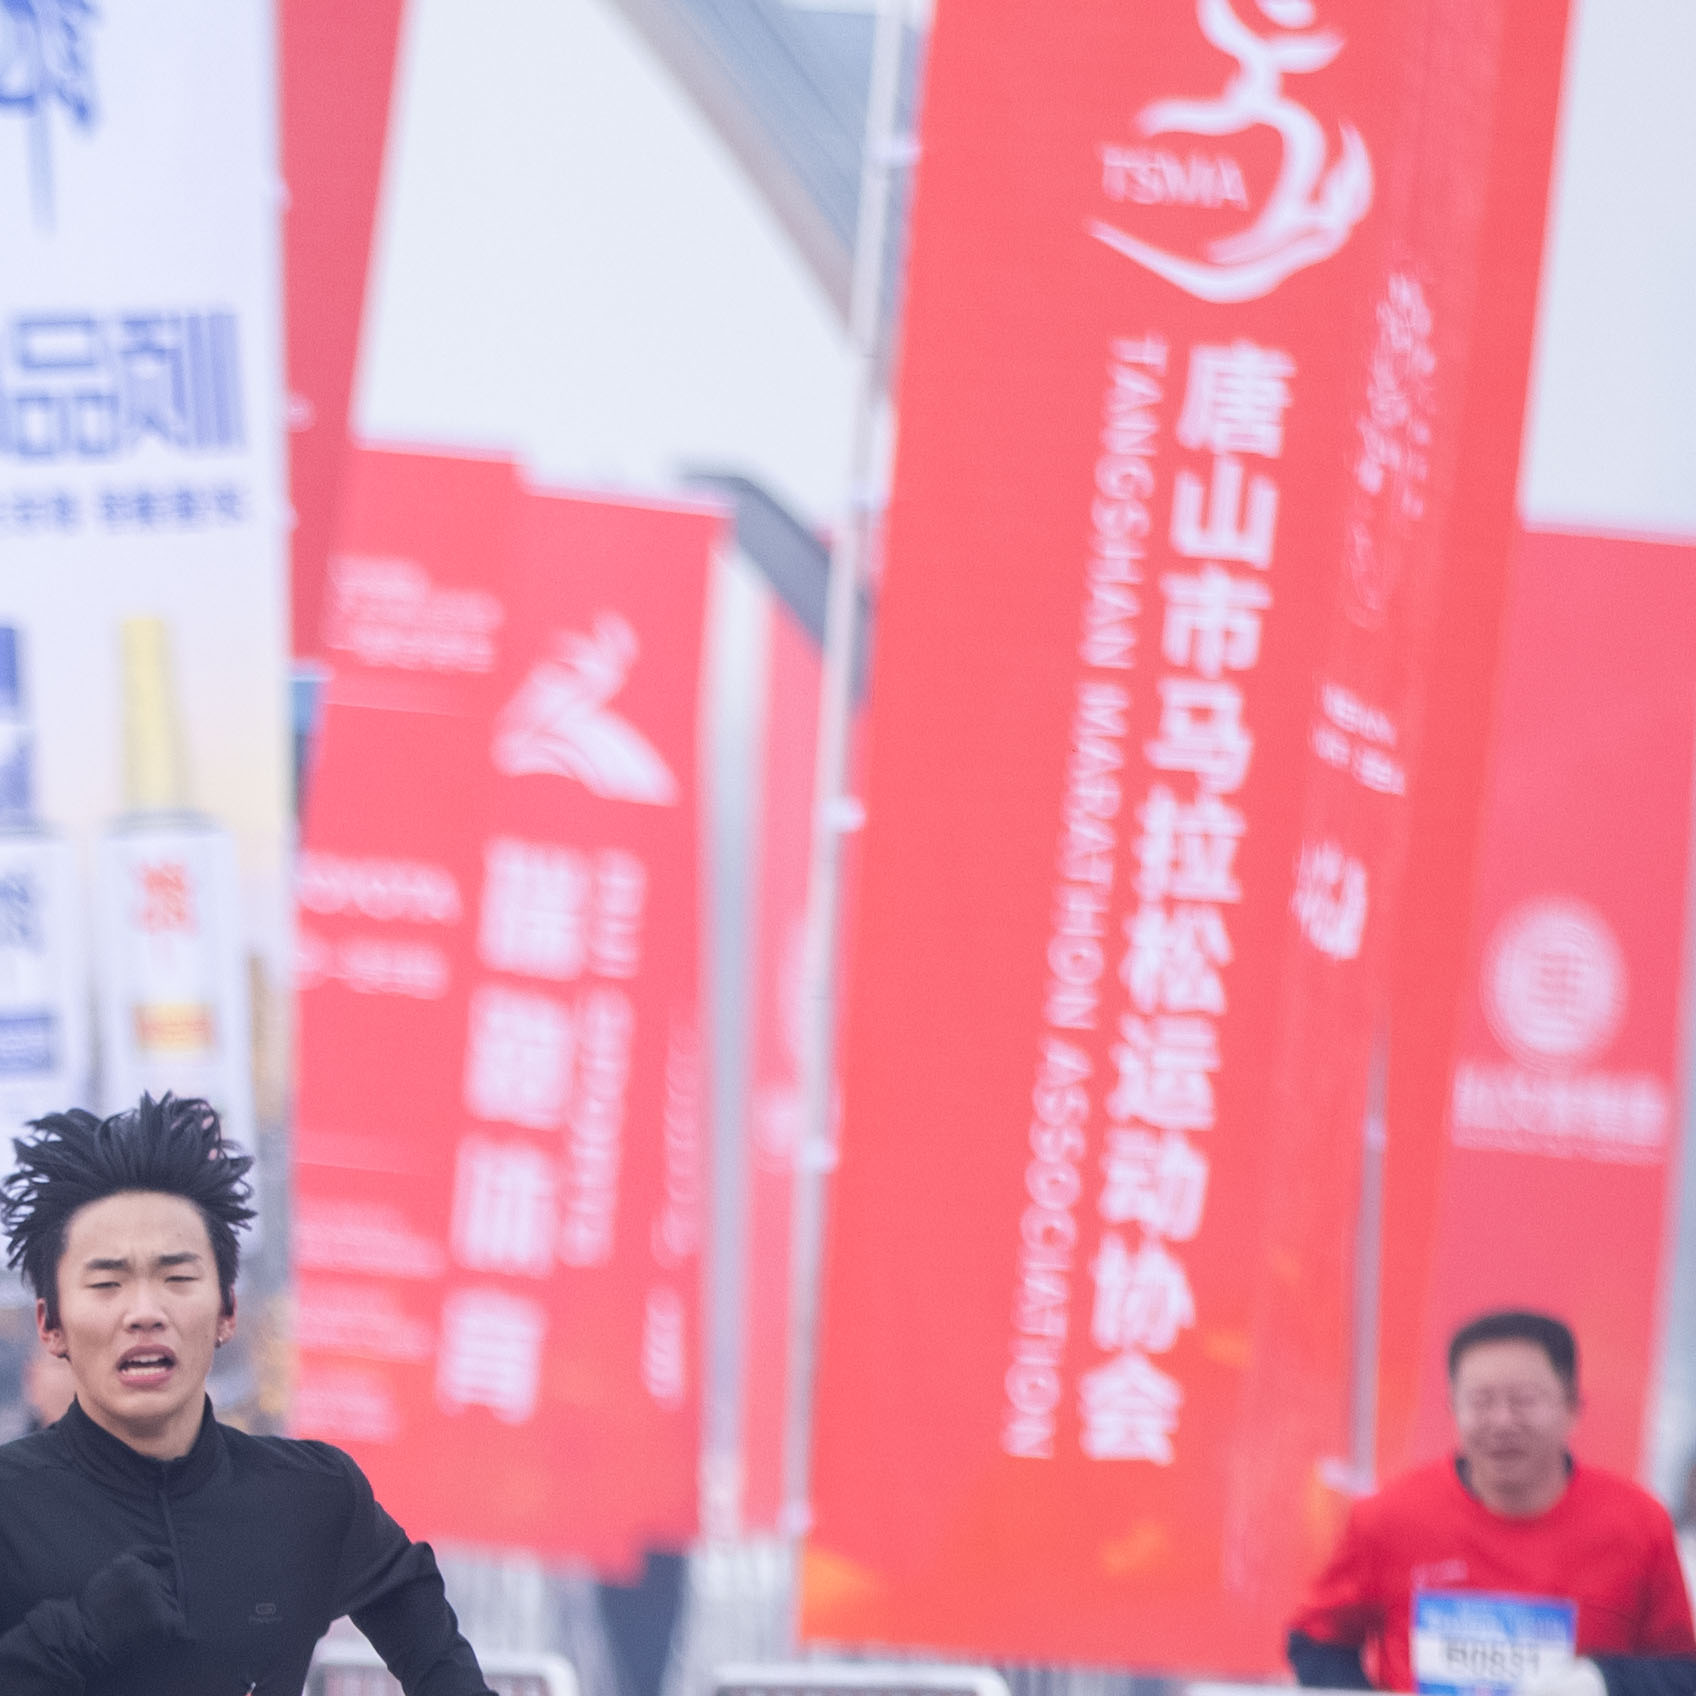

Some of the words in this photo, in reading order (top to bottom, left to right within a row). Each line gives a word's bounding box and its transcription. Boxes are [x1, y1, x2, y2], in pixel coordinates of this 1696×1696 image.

[1080, 334, 1168, 670] TANGSHAN
[1043, 680, 1130, 1029] MARATHON
[1077, 338, 1297, 1465] 唐山市马拉松运动协会
[1000, 1033, 1096, 1460] ASSOCIATION
